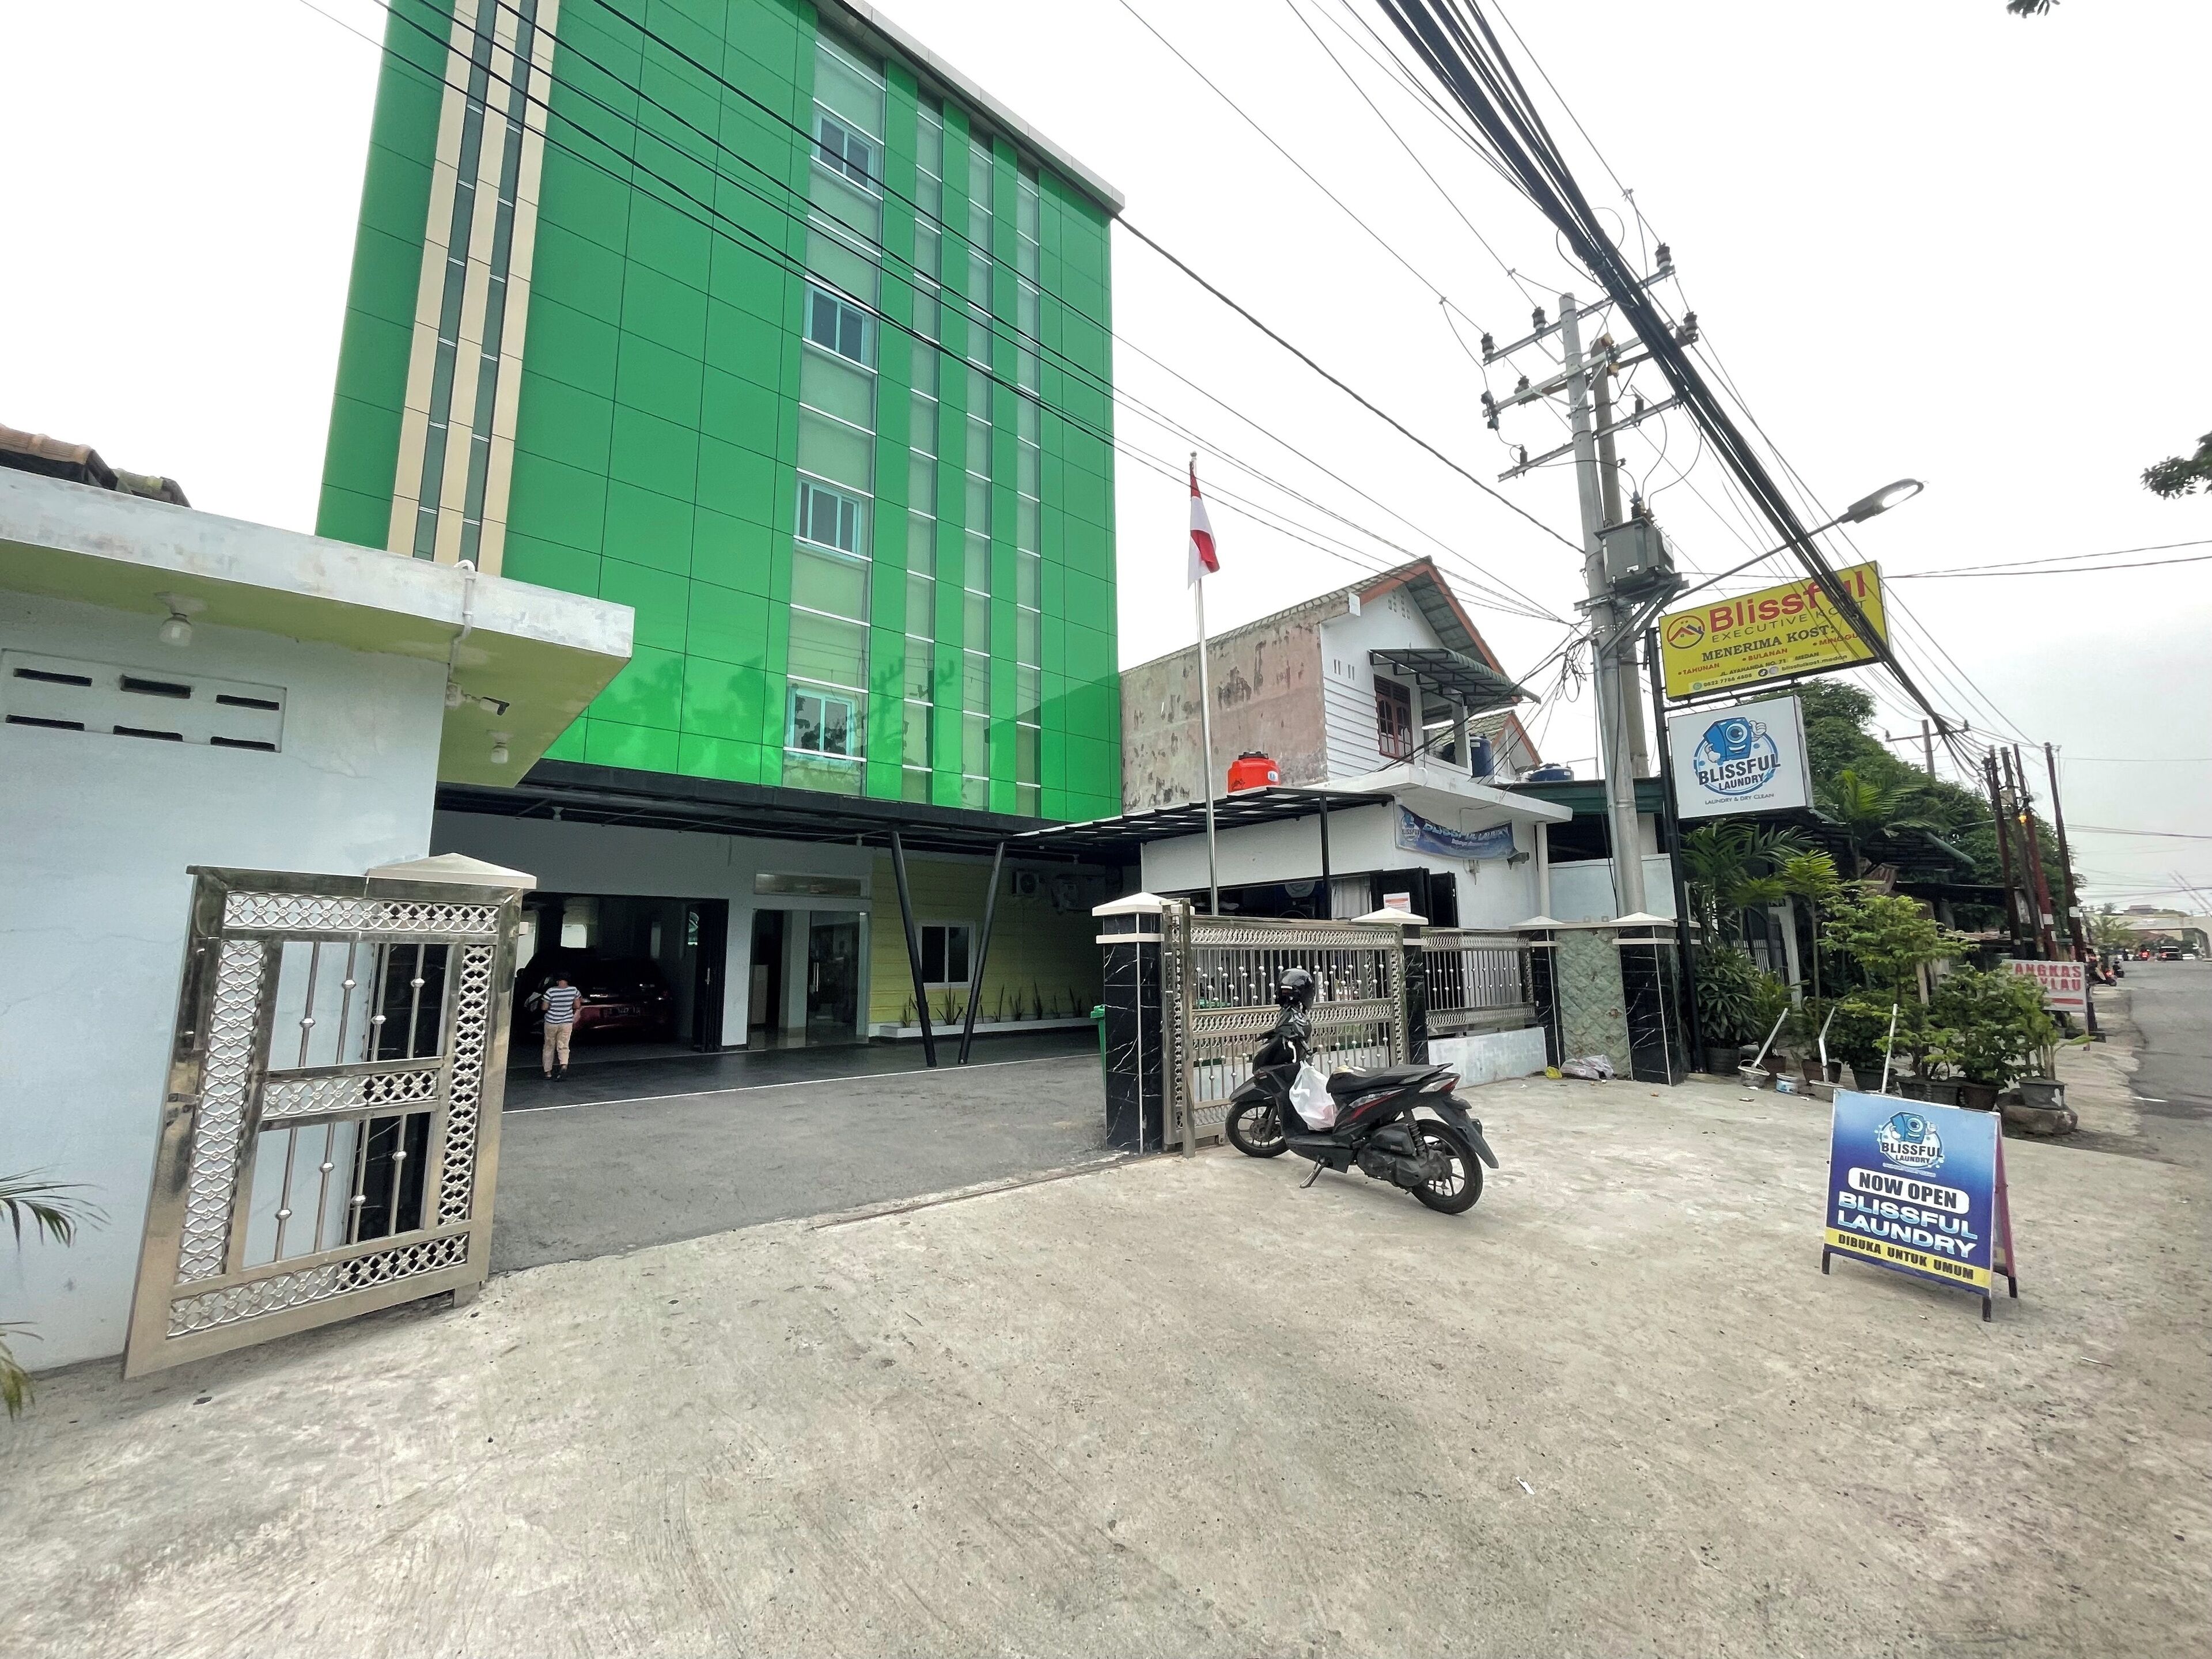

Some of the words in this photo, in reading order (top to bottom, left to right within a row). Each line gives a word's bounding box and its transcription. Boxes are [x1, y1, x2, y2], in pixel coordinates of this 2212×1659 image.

[1712, 613, 1808, 643] EXECUTIVE
[1816, 600, 1866, 619] KOT
[1701, 635, 1782, 662] MENERIMA
[1748, 648, 1787, 661] BULANAN
[1795, 652, 1819, 661] MEDAN
[1683, 662, 1720, 675] TAHUNAN
[1699, 753, 1781, 785] BLISSFUL
[1719, 772, 1765, 791] LAUNDRY
[1881, 1142, 1944, 1158] BLISSFUL
[1895, 1154, 1930, 1164] LAUNDRY
[1859, 1172, 1903, 1196] NOW
[1908, 1183, 1957, 1209] OPEN
[1838, 1190, 1978, 1240] BLISSFUL
[1837, 1210, 1977, 1259] LAUNDRY
[1838, 1234, 1881, 1255] DIBUKA
[1887, 1247, 1927, 1267] UNTUK
[1933, 1259, 1974, 1280] UMUM
